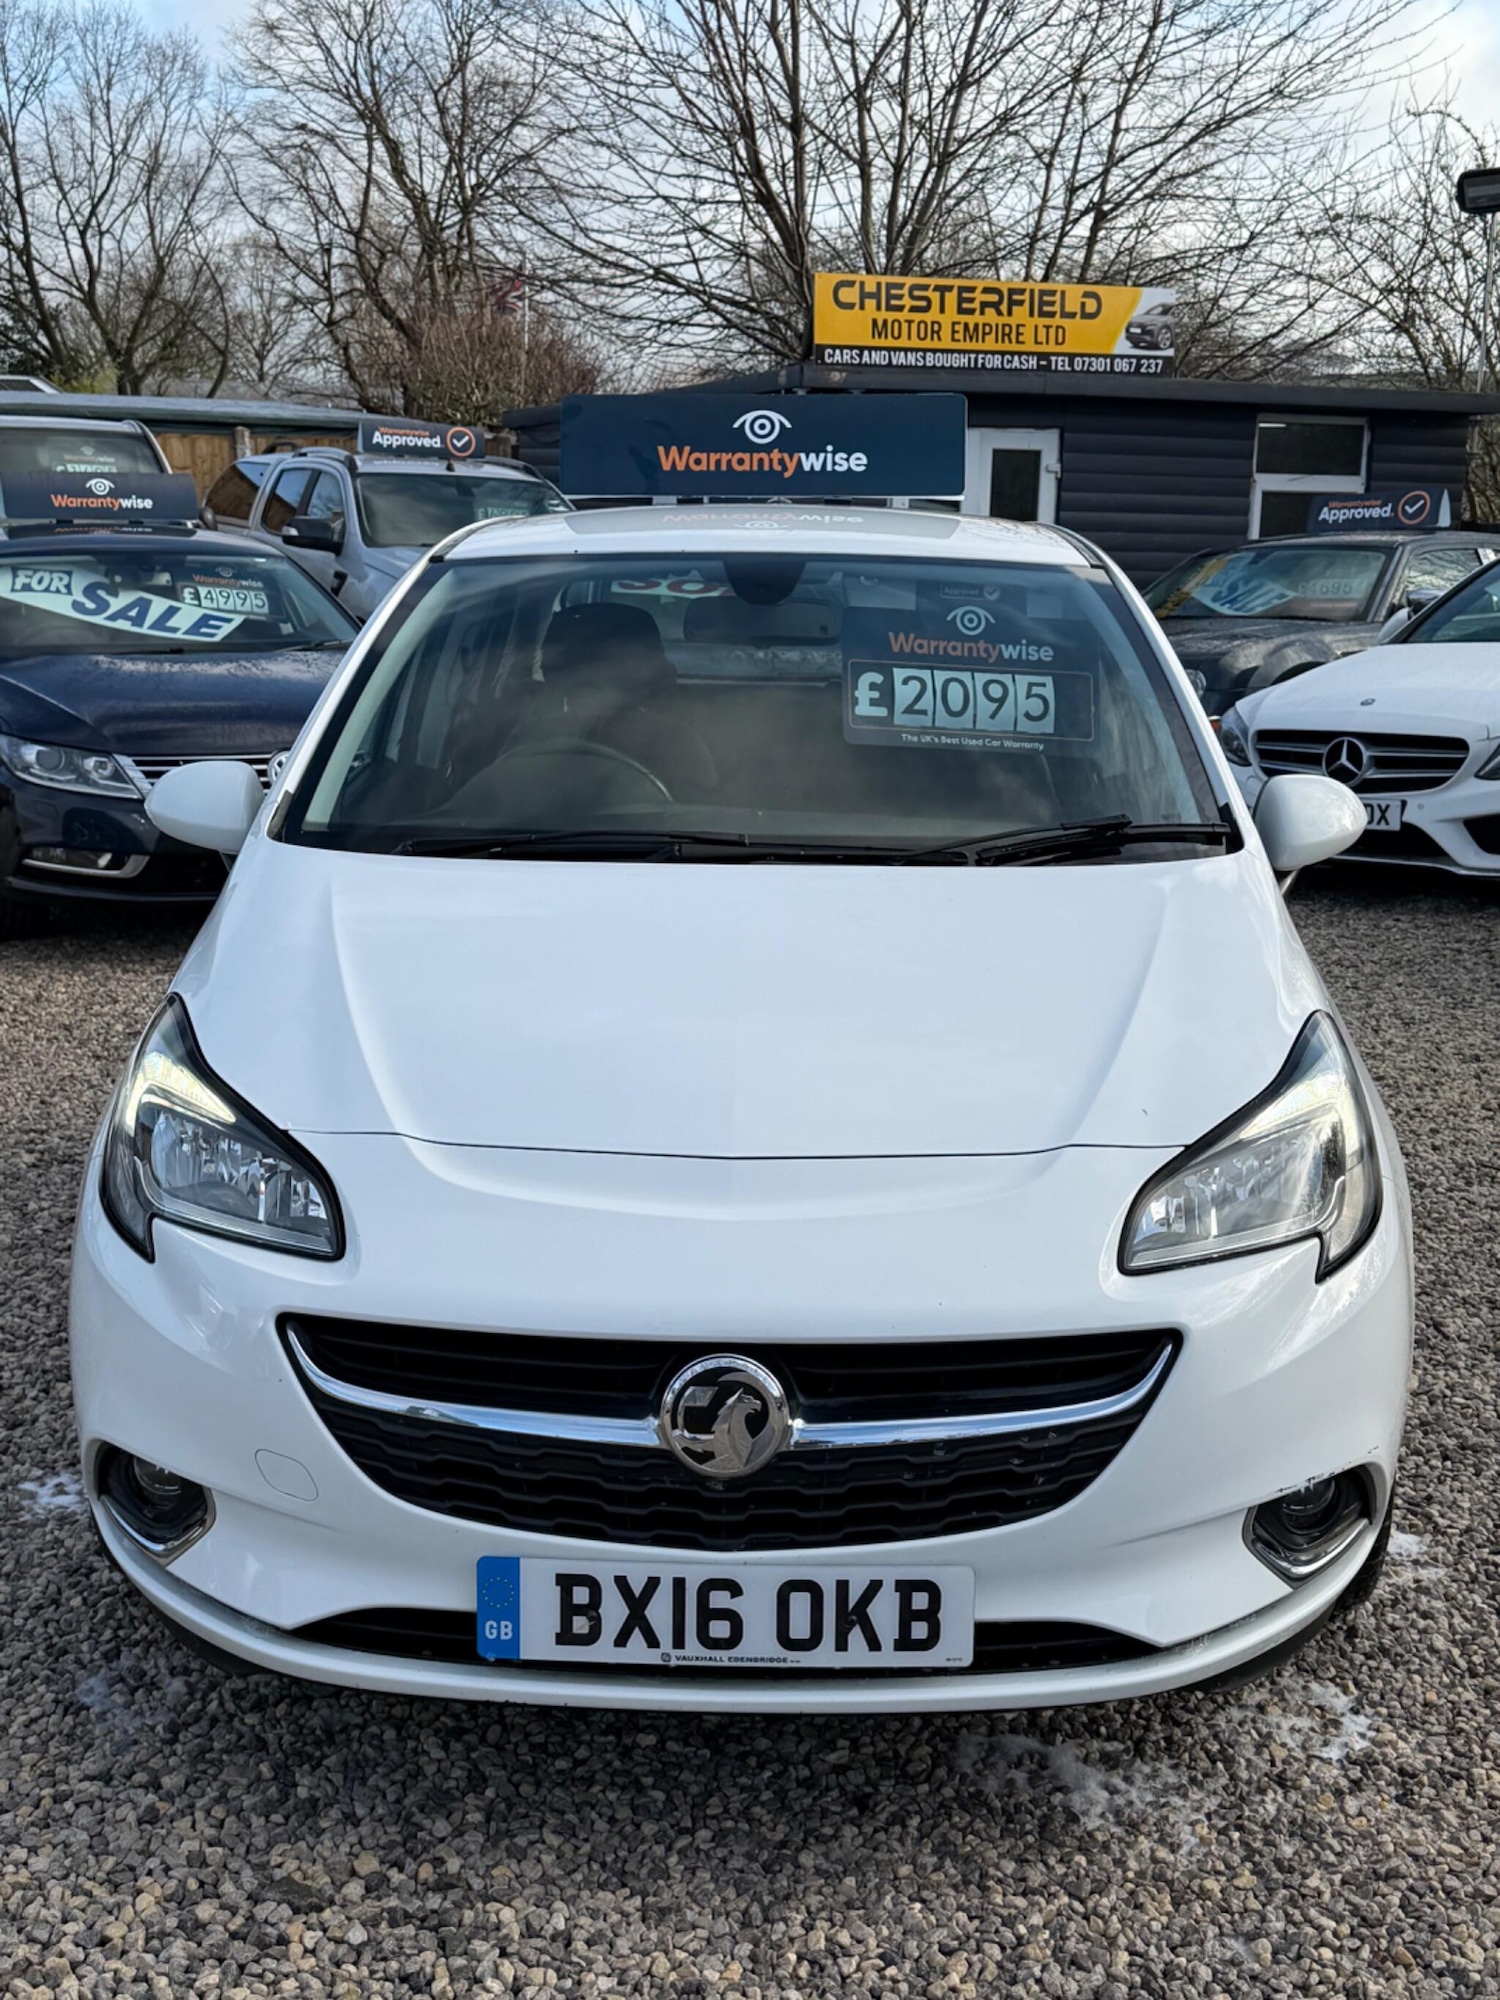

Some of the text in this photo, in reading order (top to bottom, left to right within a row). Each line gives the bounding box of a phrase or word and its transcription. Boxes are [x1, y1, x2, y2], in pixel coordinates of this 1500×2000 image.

[833, 280, 1103, 320] CHESTERFIELD
[872, 318, 1067, 346] MOTOR EMPIRE LTD
[824, 348, 860, 364] CARS
[862, 350, 889, 365] AND
[890, 351, 924, 367] VANS
[926, 352, 976, 368] BOUGHT
[978, 354, 1002, 369] FOR
[1003, 354, 1038, 370] CASH
[1050, 356, 1072, 371] TEL
[1074, 357, 1111, 372] 07301
[1114, 358, 1137, 373] 067
[1140, 359, 1163, 374] 237
[657, 444, 868, 479] Warrantywise
[51, 494, 153, 512] Warrantywise
[192, 573, 264, 589] Warrantywise
[13, 568, 235, 639] FOR SALE
[183, 587, 267, 609] £4995
[888, 632, 1055, 664] Warrantywise
[854, 671, 1050, 723] £2095
[901, 733, 1045, 751] The UK's Best Used Car Warranty
[555, 1573, 942, 1653] BX16 OKB
[485, 1620, 513, 1640] GB
[674, 1654, 789, 1664] VAUXHALL EDENBRIDGE
